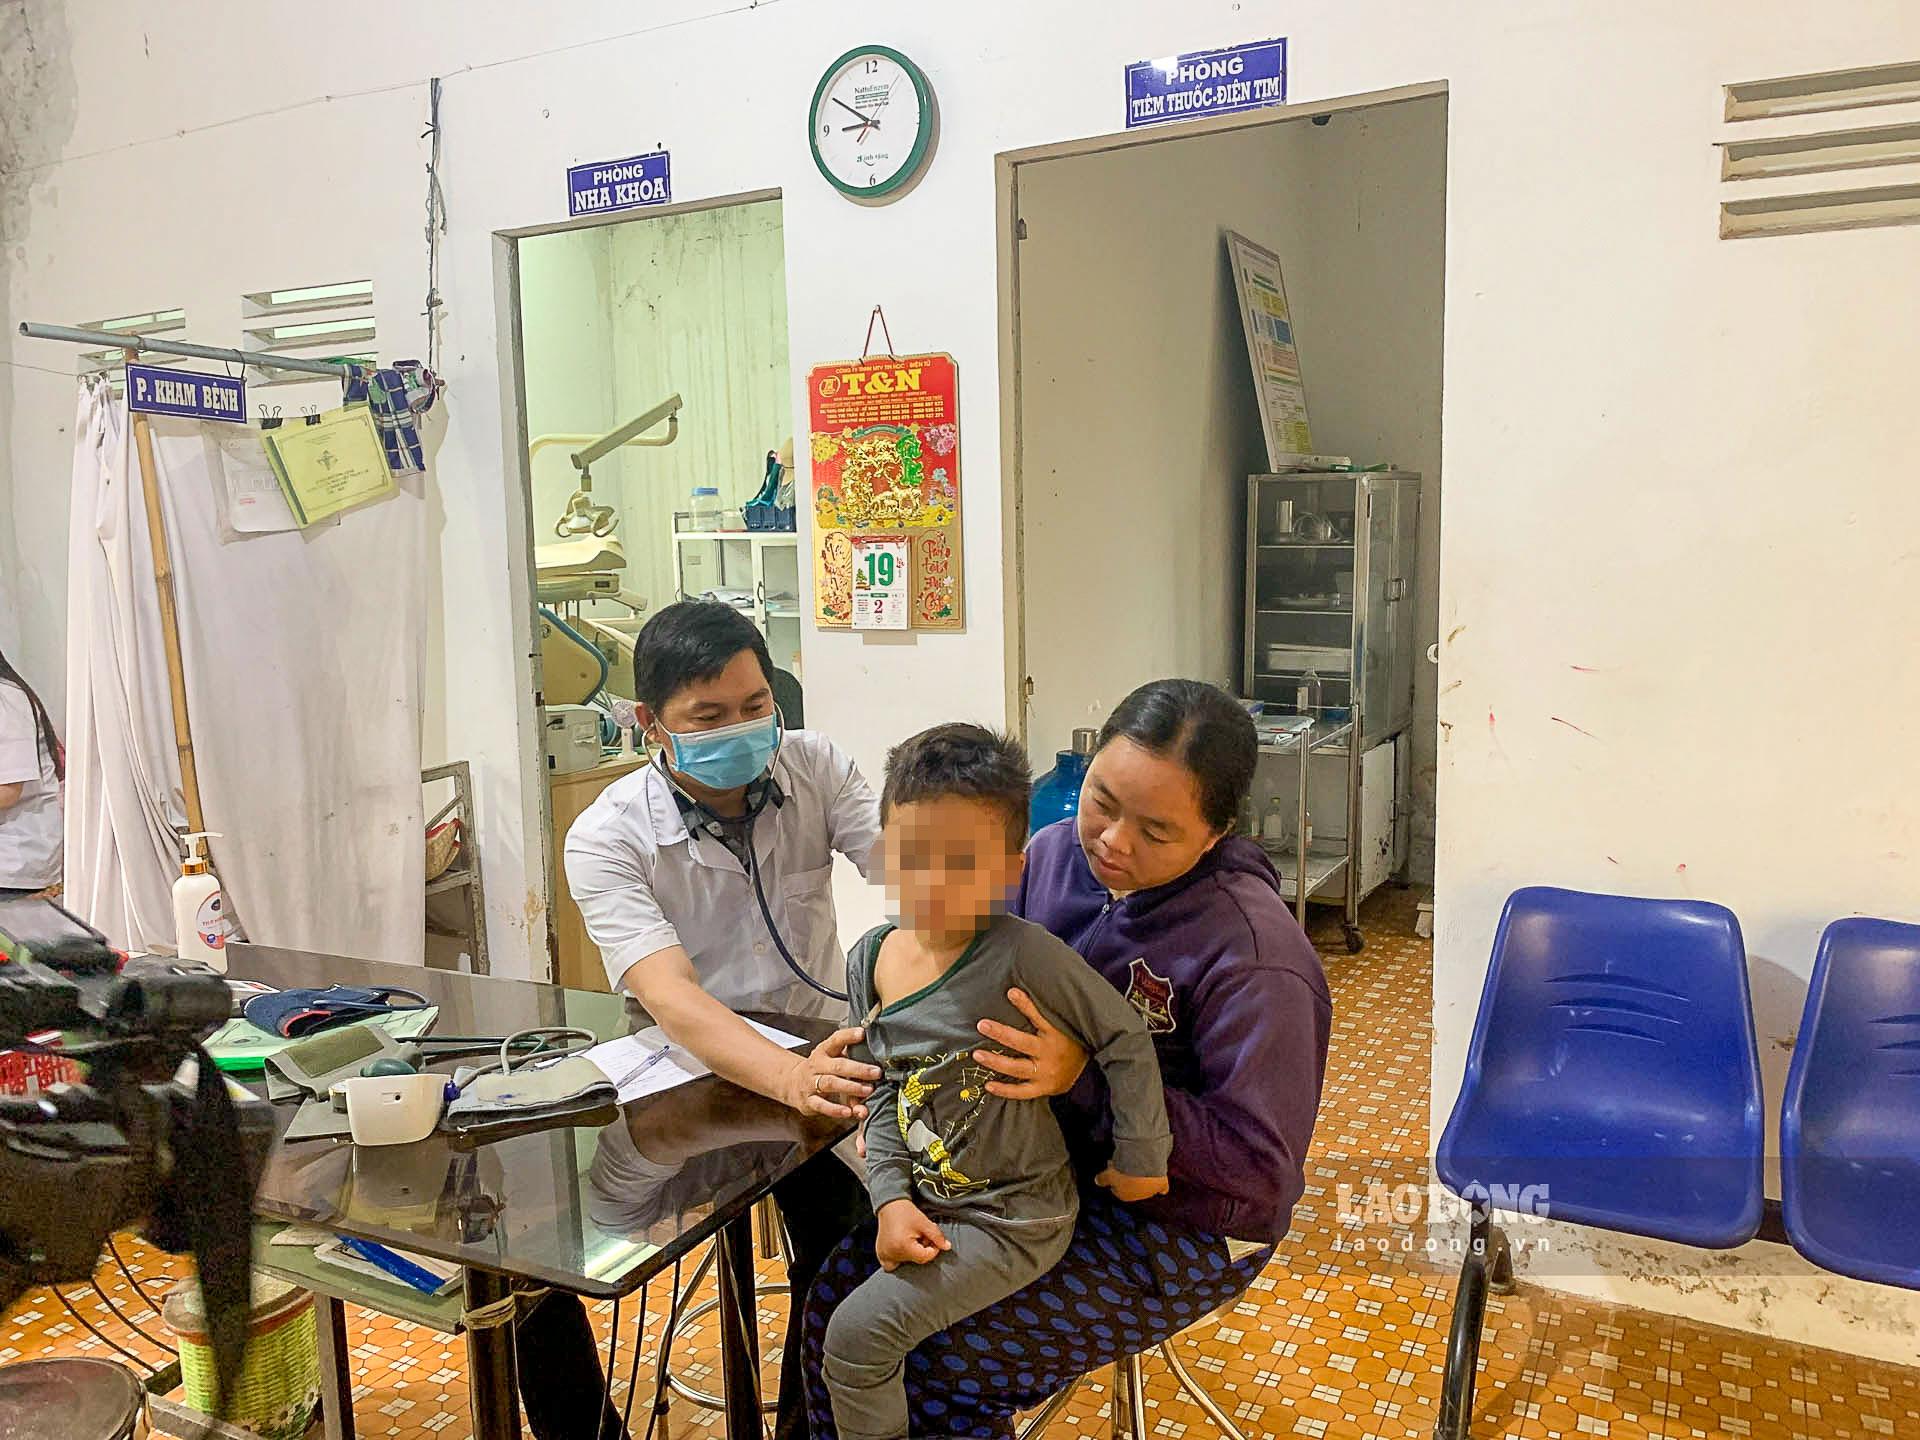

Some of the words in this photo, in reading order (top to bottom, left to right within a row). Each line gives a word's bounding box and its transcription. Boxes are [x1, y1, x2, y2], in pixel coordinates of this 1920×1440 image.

[865, 60, 878, 74] 12
[1253, 77, 1280, 99] TIM
[823, 124, 831, 138] 9
[869, 173, 876, 186] 6
[574, 187, 612, 211] NHA
[614, 178, 666, 205] KHOA
[136, 377, 152, 402] P.
[842, 368, 922, 396] T&N
[864, 552, 894, 586] 19
[873, 599, 883, 614] 2
